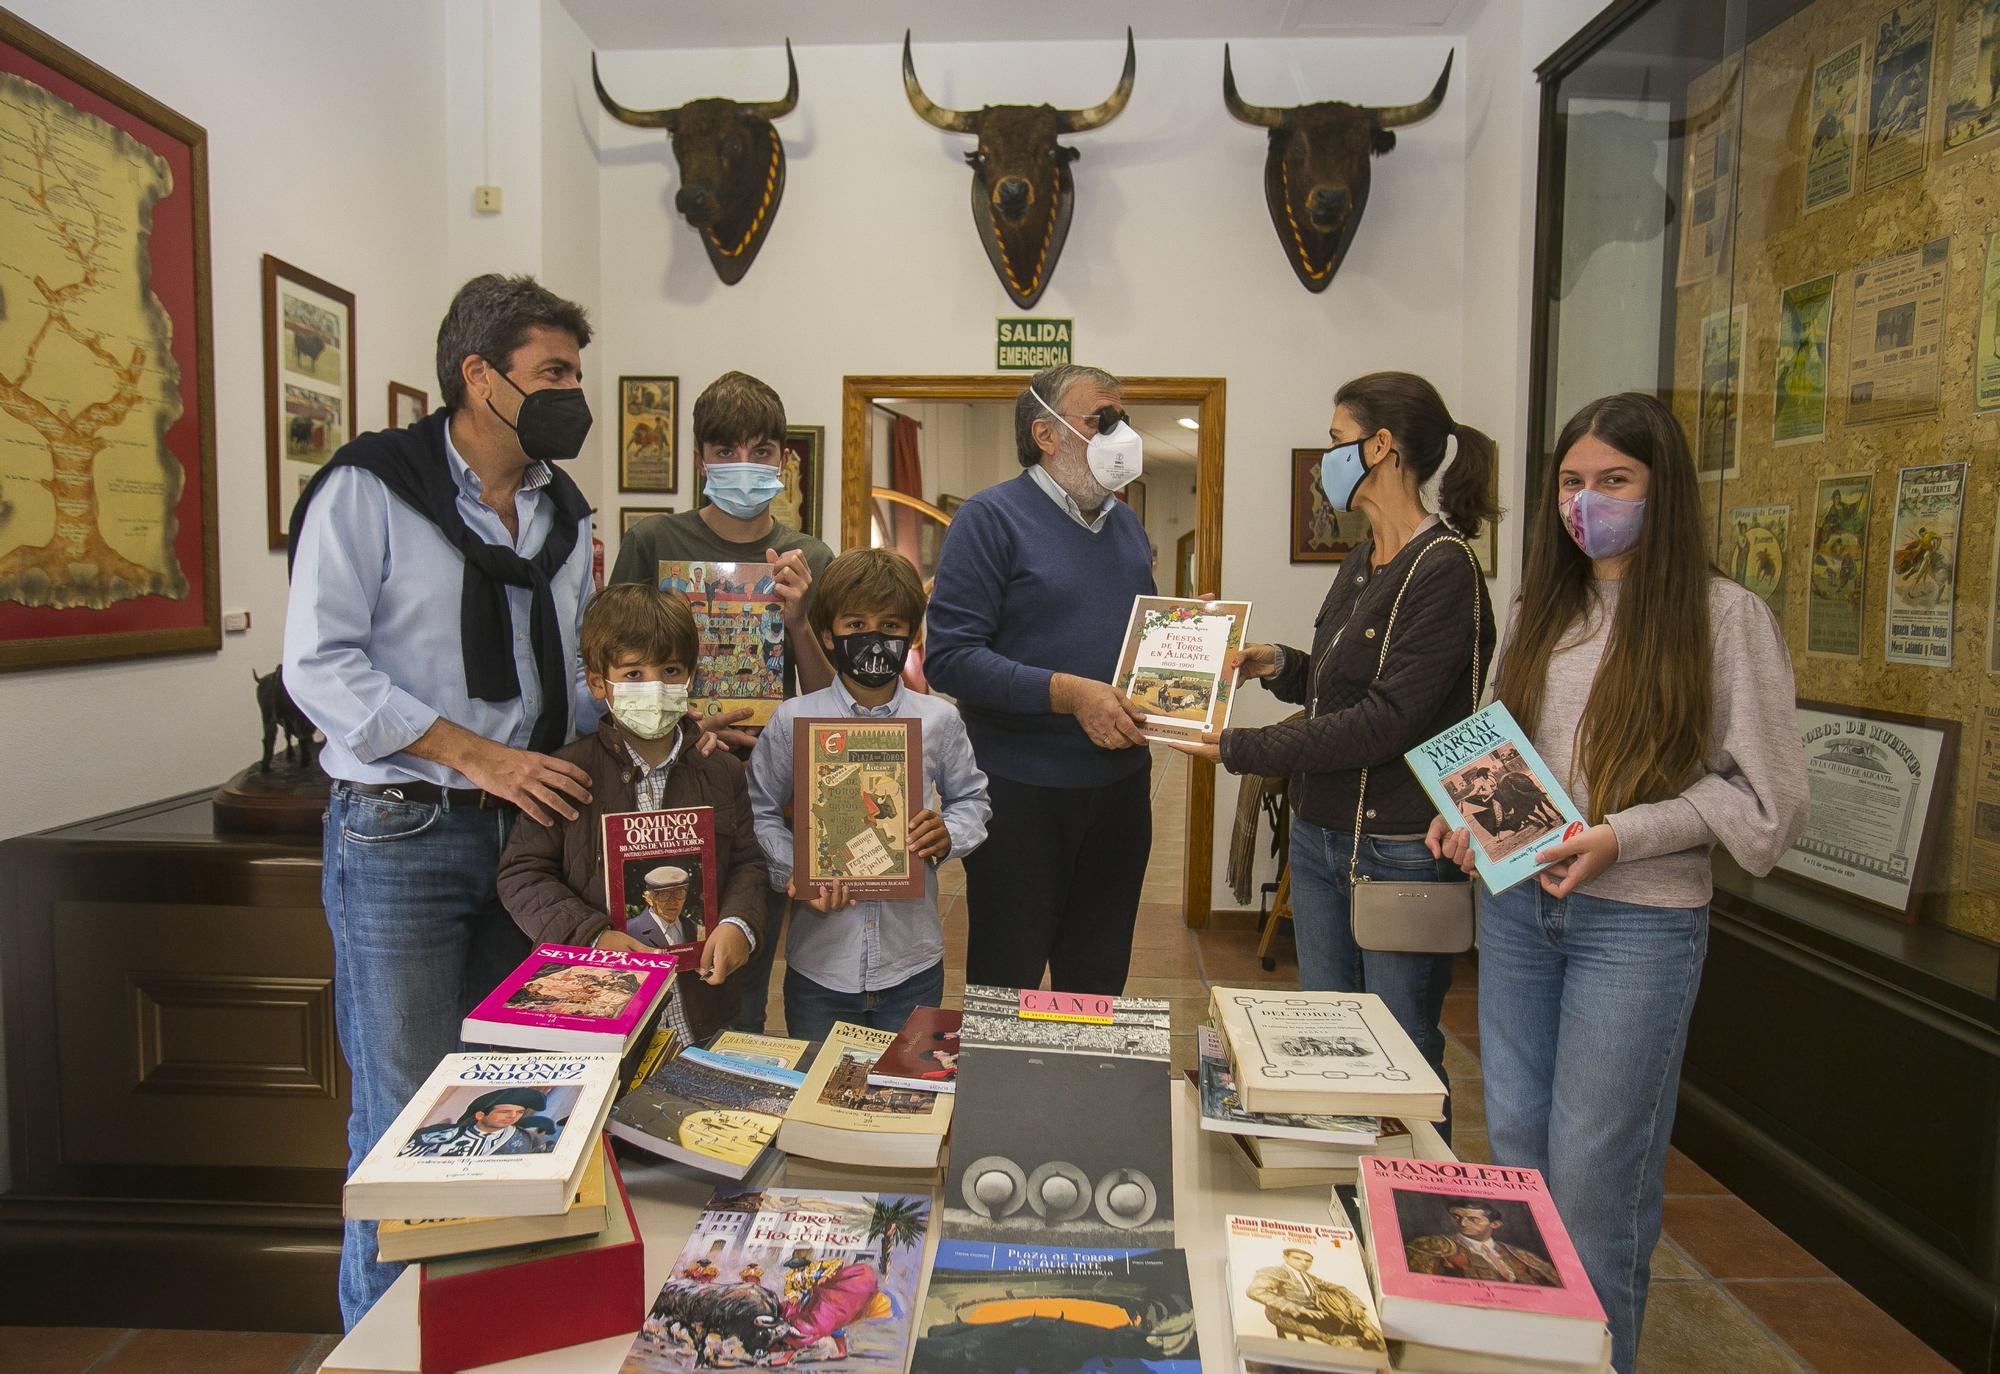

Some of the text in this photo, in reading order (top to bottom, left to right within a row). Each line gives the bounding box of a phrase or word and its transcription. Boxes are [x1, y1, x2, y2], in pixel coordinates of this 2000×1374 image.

[1000, 323, 1069, 342] SALIDA
[999, 346, 1069, 366] EMERGENCIA
[1166, 632, 1203, 643] FIESTAS
[1161, 641, 1204, 652] DE TOROS
[1150, 649, 1210, 661] EN ALICANTE
[1420, 711, 1492, 754] LA TAUROMAQUIA DE
[1845, 720, 1866, 735] DE
[1427, 720, 1496, 762] MARCIAL
[1434, 730, 1501, 771] LALANDA
[1827, 762, 1850, 774] CIUDAD
[623, 812, 698, 831] DOMINGO
[626, 826, 698, 844] ORTEGA
[648, 842, 659, 850] DE
[659, 840, 676, 849] VIDA
[682, 838, 705, 847] TOROS
[537, 949, 672, 969] SEVILLANAS
[591, 949, 628, 958] POR
[1024, 994, 1109, 1014] CANO
[836, 1029, 890, 1046] DEL TOR
[466, 1063, 586, 1072] ANTONIO
[1373, 1159, 1537, 1184] MANOLETE
[1430, 1175, 1449, 1184] DE
[1449, 1177, 1540, 1193] ALTERNATIVA
[785, 1212, 843, 1227] TOROS
[1231, 1217, 1258, 1227] Juan
[1260, 1219, 1312, 1233] Belmonte
[804, 1225, 812, 1233] Y
[754, 1230, 861, 1246] HOGUERAS
[1008, 1248, 1048, 1260] PLAZA
[1073, 1252, 1114, 1262] TOROS
[1018, 1258, 1101, 1270] DE ALICANTE
